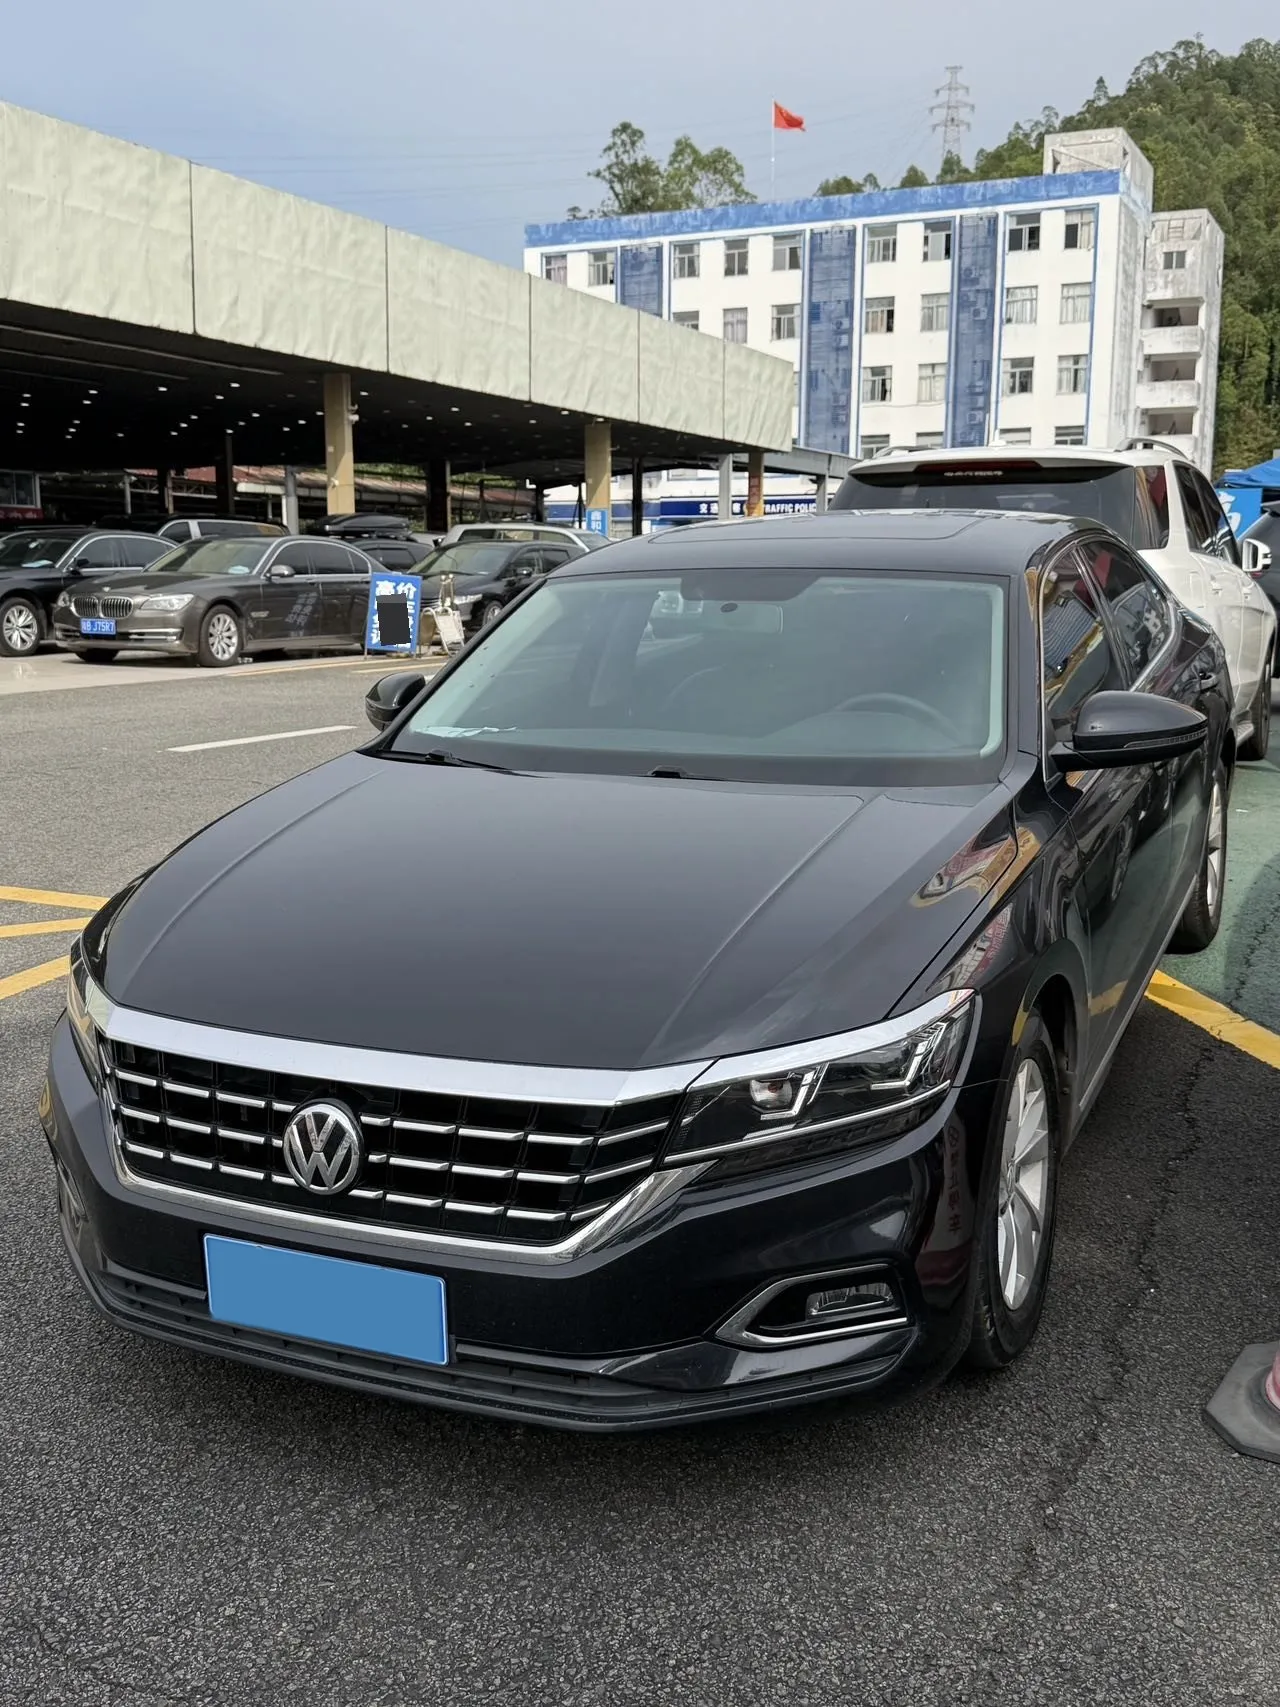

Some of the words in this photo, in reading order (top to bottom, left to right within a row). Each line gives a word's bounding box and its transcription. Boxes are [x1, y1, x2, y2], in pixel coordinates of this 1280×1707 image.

[699, 502, 741, 514] 交通察
[764, 503, 793, 514] RAFFIC
[794, 502, 817, 513] POLIC
